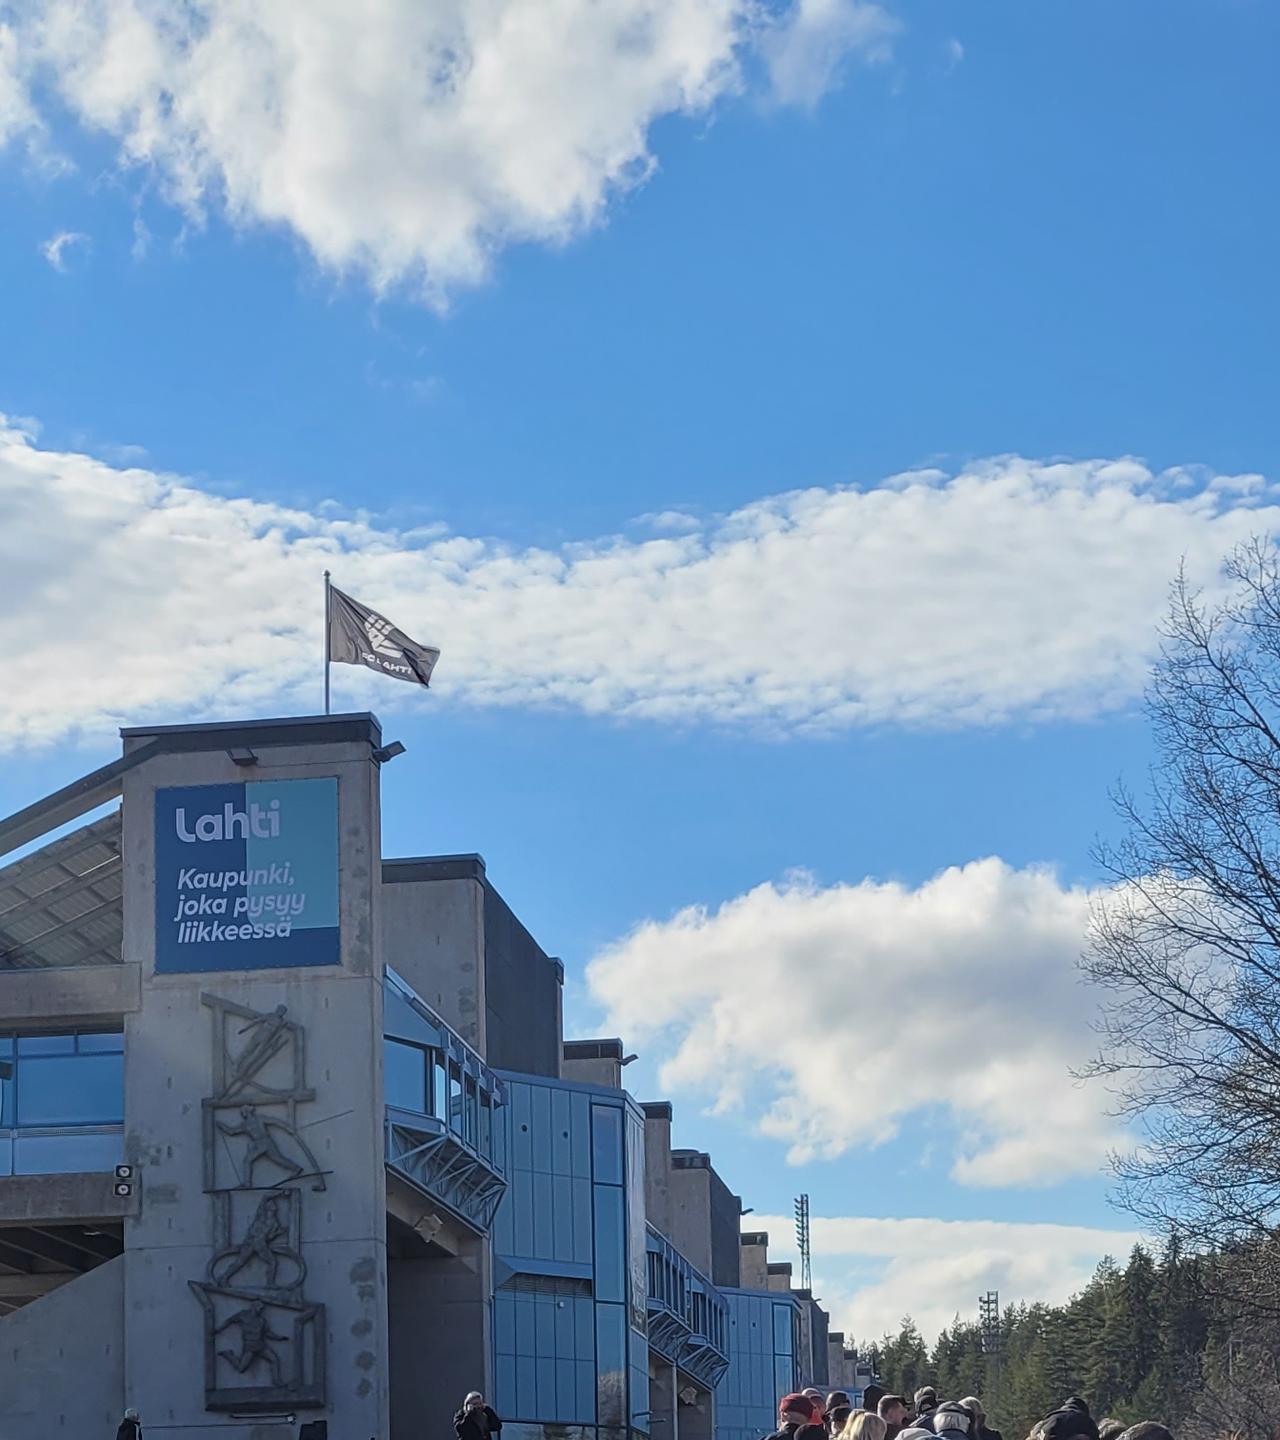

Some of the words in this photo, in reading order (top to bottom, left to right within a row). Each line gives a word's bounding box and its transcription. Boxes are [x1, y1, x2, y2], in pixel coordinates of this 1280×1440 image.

[376, 657, 412, 674] LAHTI
[176, 800, 281, 843] Lahti
[177, 862, 295, 892] Kaupunki,
[173, 894, 228, 922] joka
[233, 893, 306, 918] pysyy
[177, 916, 292, 944] liikkeessä
